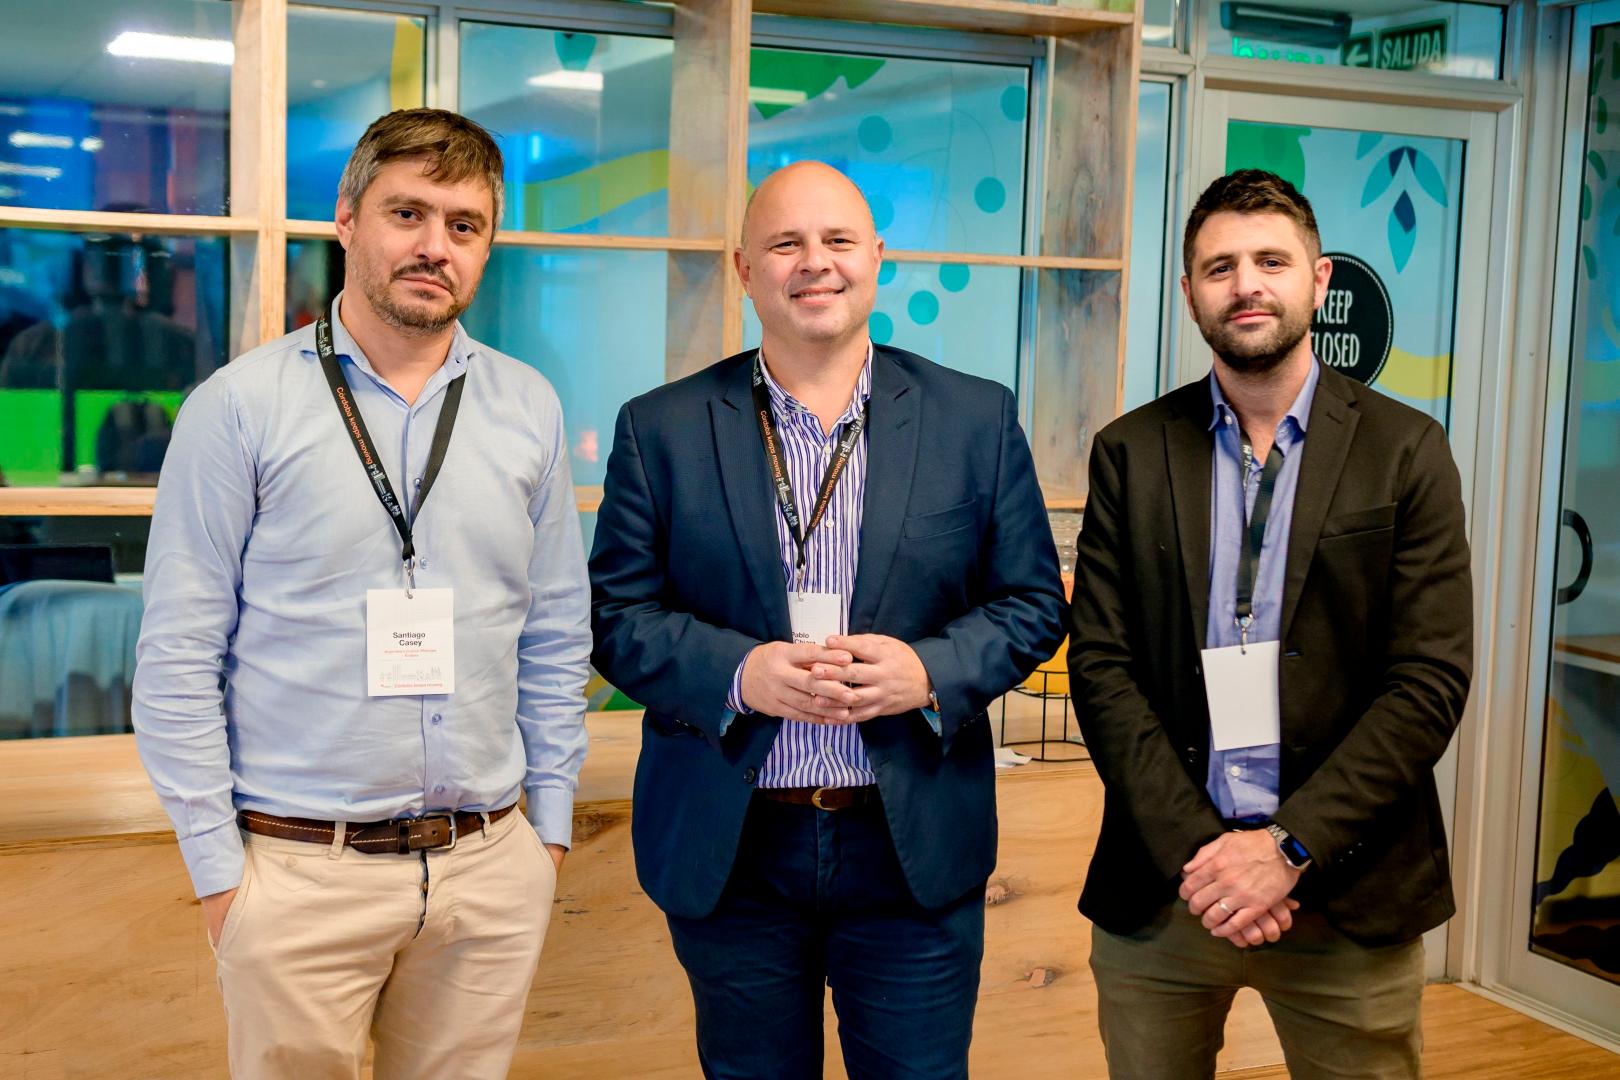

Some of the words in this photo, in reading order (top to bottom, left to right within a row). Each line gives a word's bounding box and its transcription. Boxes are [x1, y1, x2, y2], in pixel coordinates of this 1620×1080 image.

[1380, 30, 1442, 69] SALIDA
[1317, 289, 1353, 325] KEEP
[1310, 332, 1360, 368] LOSED
[336, 386, 353, 418] Córdoba
[349, 417, 362, 439] keeps
[358, 438, 373, 465] moving
[766, 435, 776, 454] keeps
[772, 454, 782, 478] moving
[822, 479, 835, 499] keeps
[831, 456, 846, 479] moving
[392, 631, 426, 640] Santiago
[399, 639, 423, 647] Casey
[791, 631, 810, 639] Pablo
